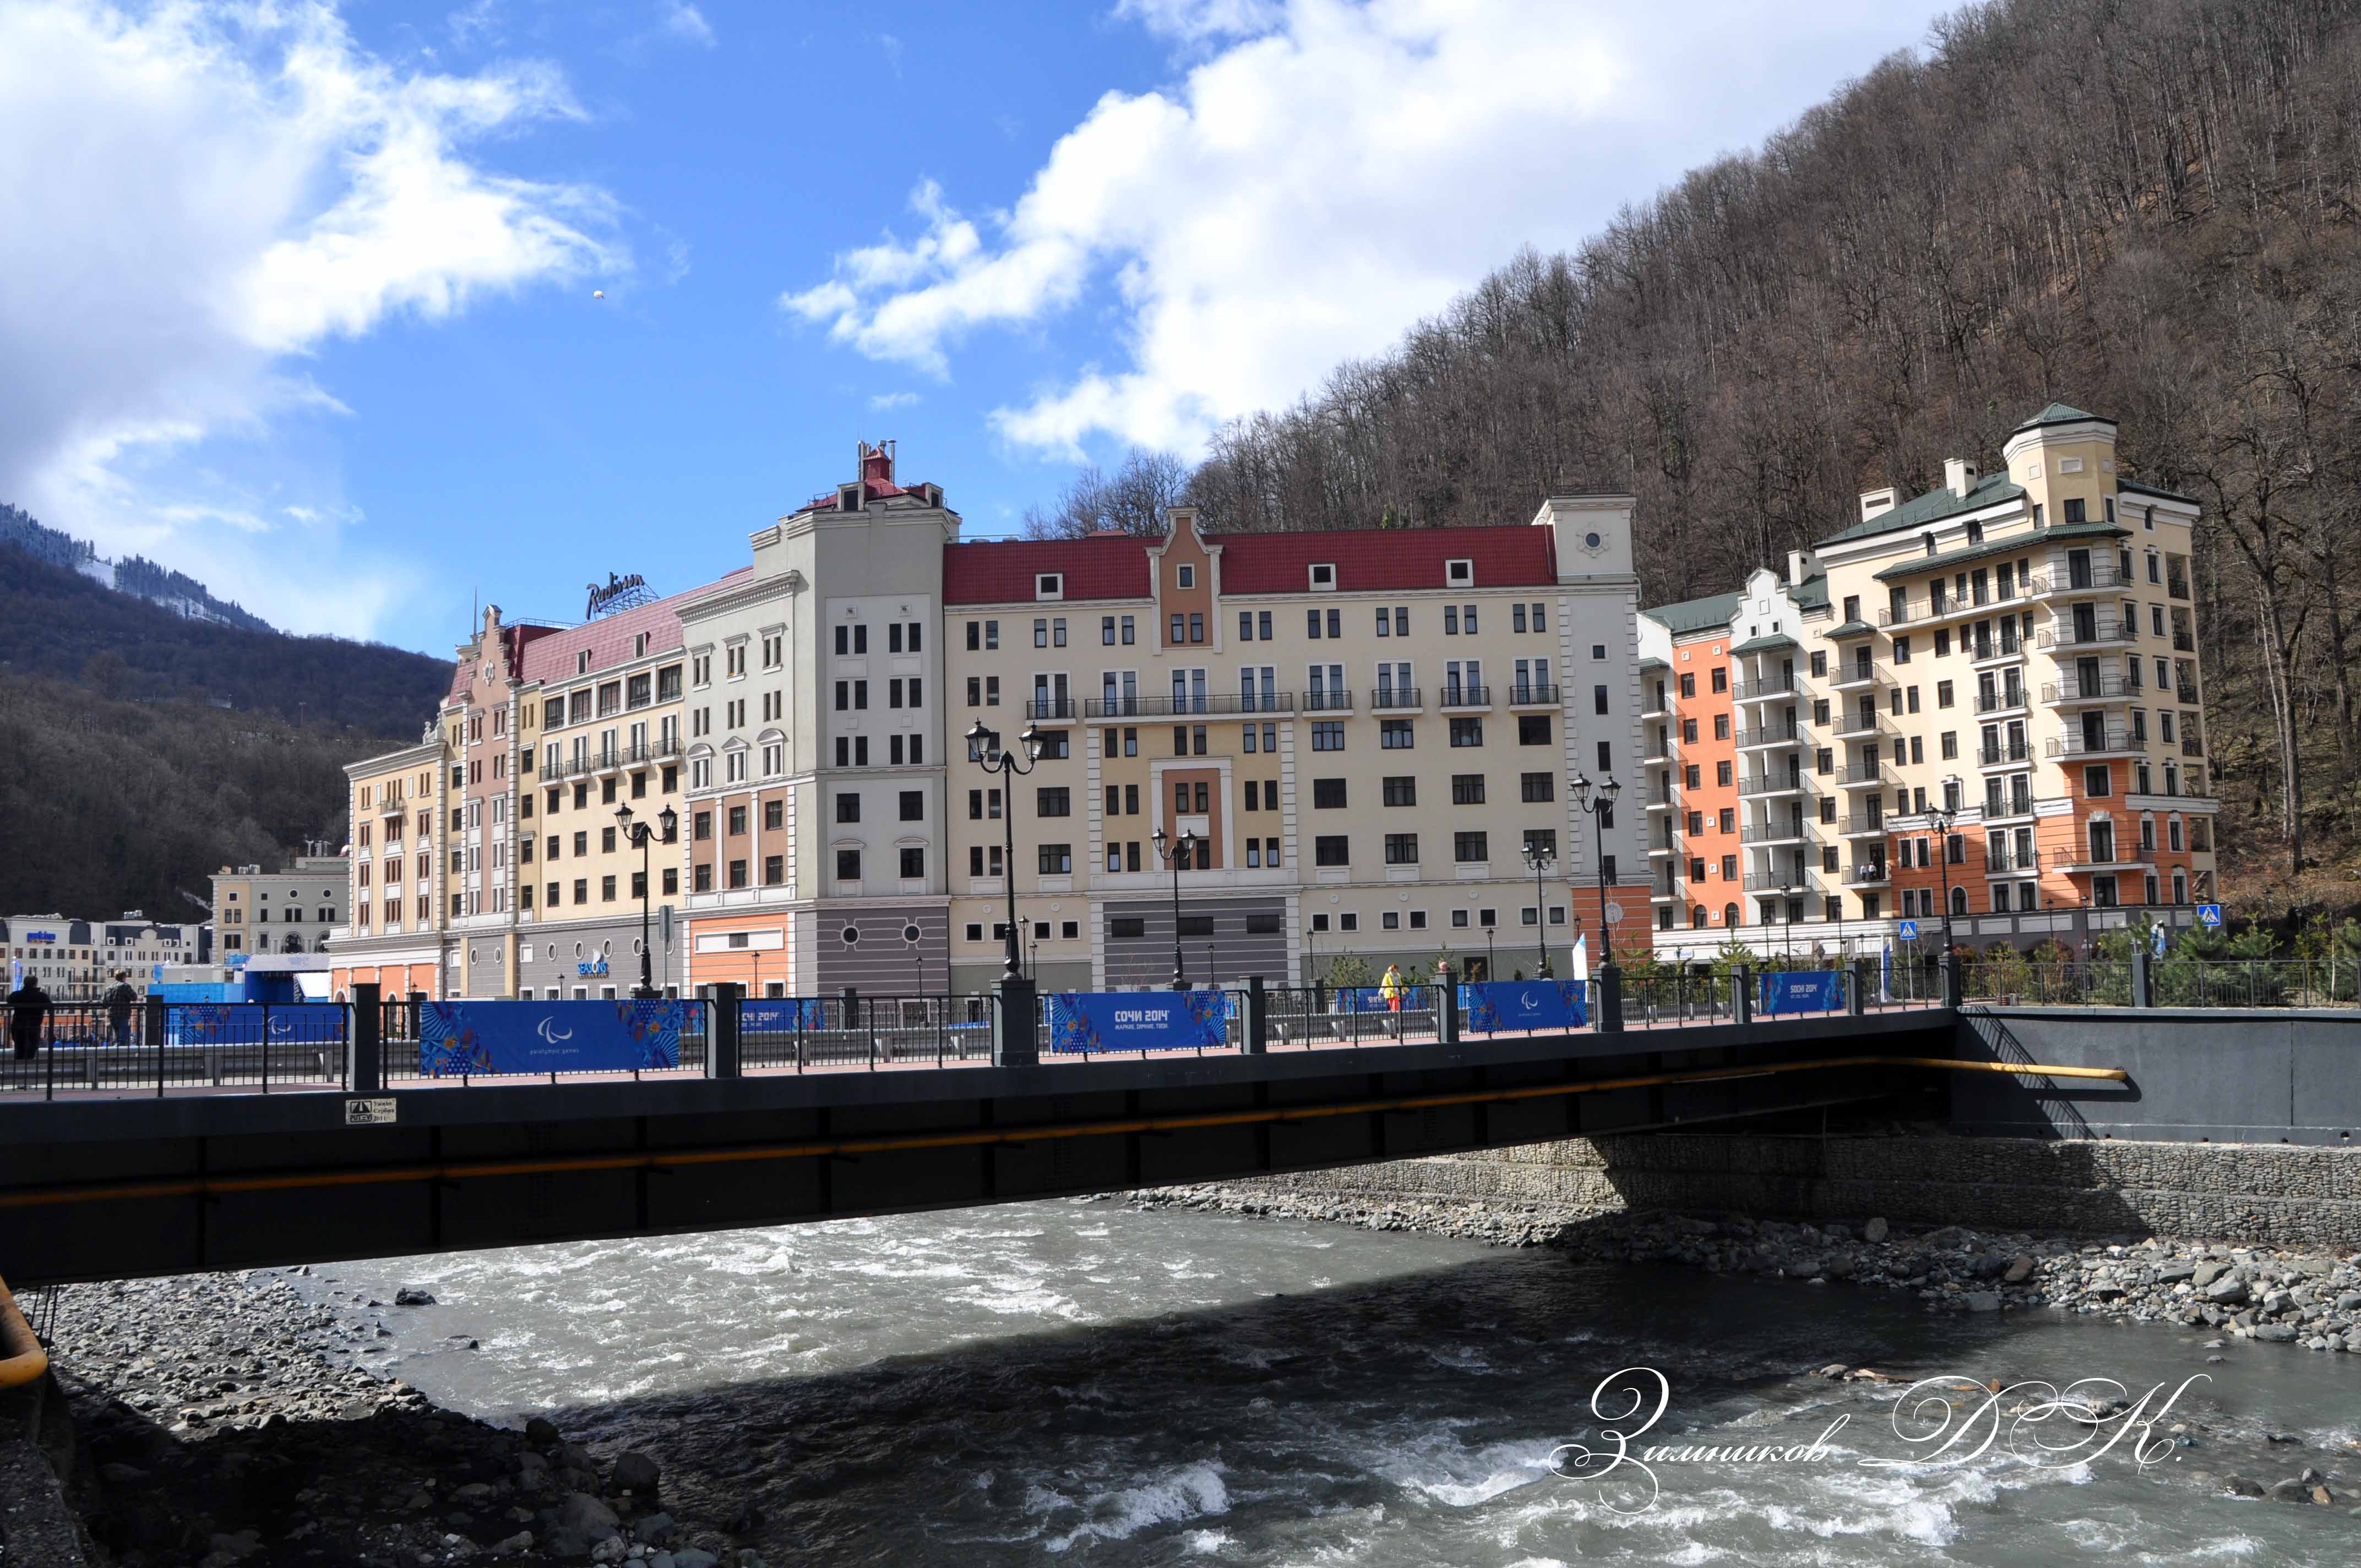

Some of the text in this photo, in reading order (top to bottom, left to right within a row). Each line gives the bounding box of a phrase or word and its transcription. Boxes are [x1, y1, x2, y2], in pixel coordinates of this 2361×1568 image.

[585, 571, 644, 620] Radisson
[577, 960, 608, 974] SEASONS
[1114, 1010, 1168, 1022] СОЧИ 2014
